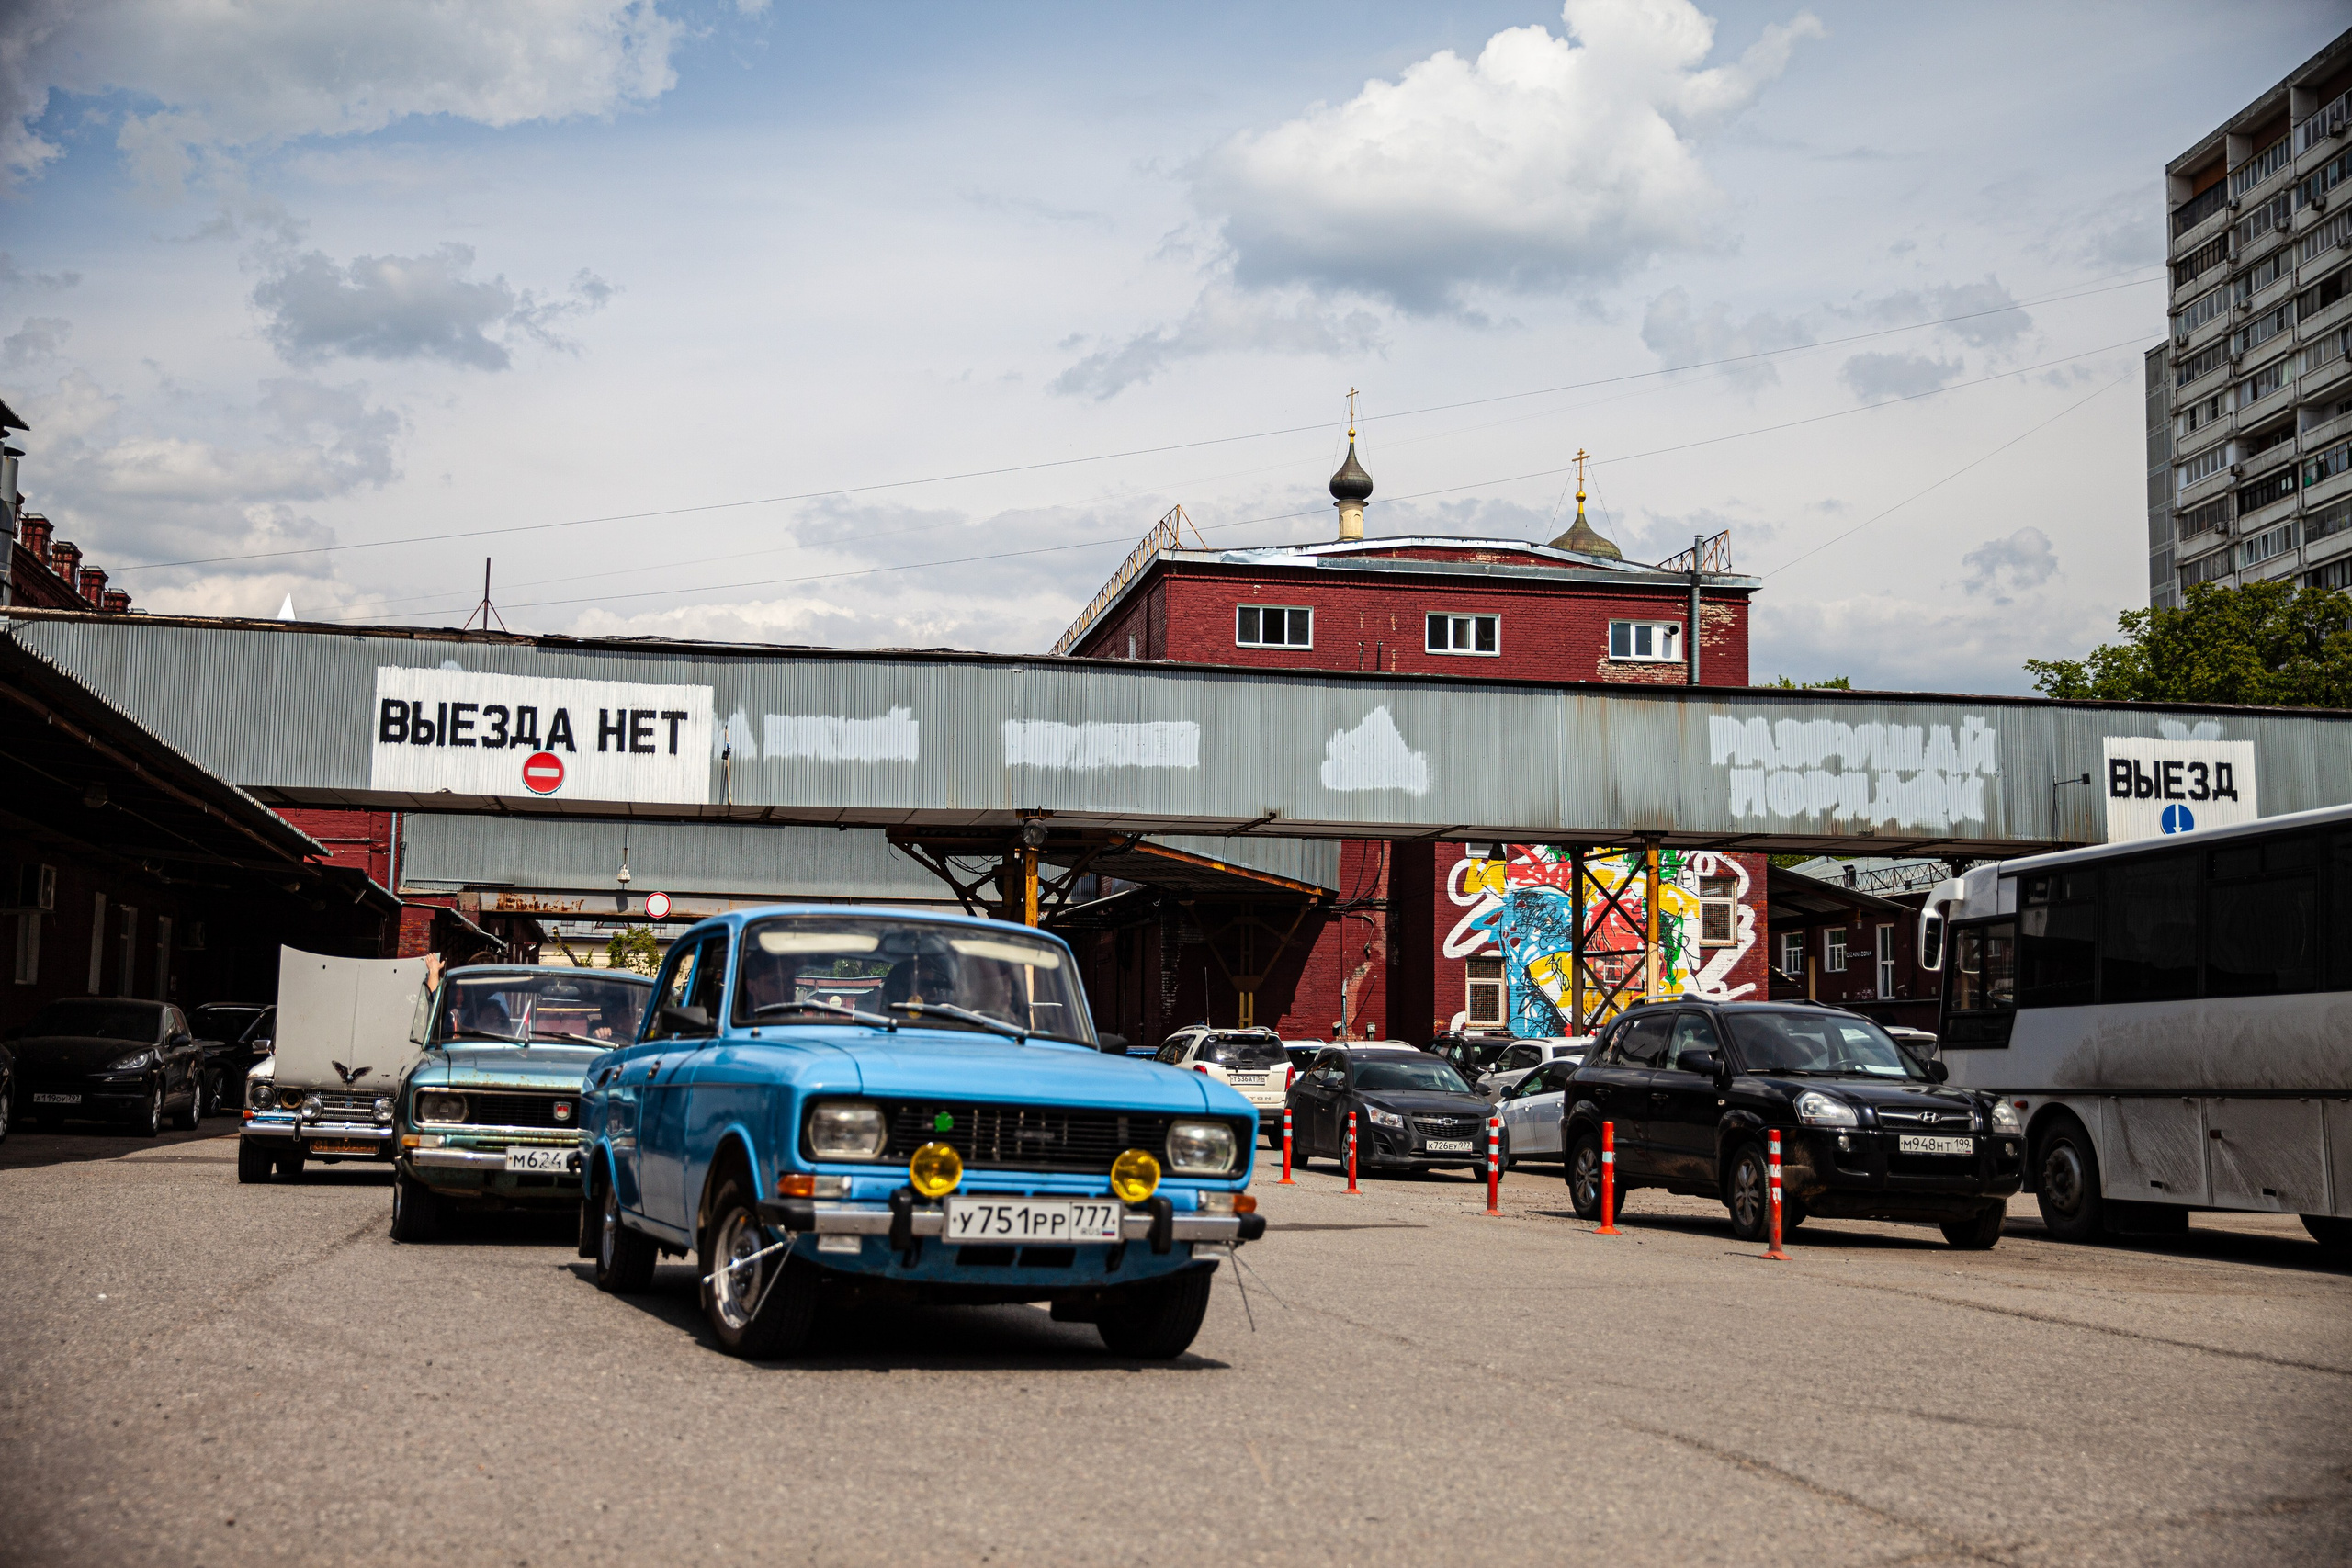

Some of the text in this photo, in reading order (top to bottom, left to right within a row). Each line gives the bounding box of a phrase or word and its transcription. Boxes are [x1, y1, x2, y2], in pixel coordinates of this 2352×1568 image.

[379, 698, 688, 756] ВЫЕЗДА НЕТ
[2109, 758, 2238, 802] ВЫЕЗД
[1080, 1226, 1101, 1235] RUS
